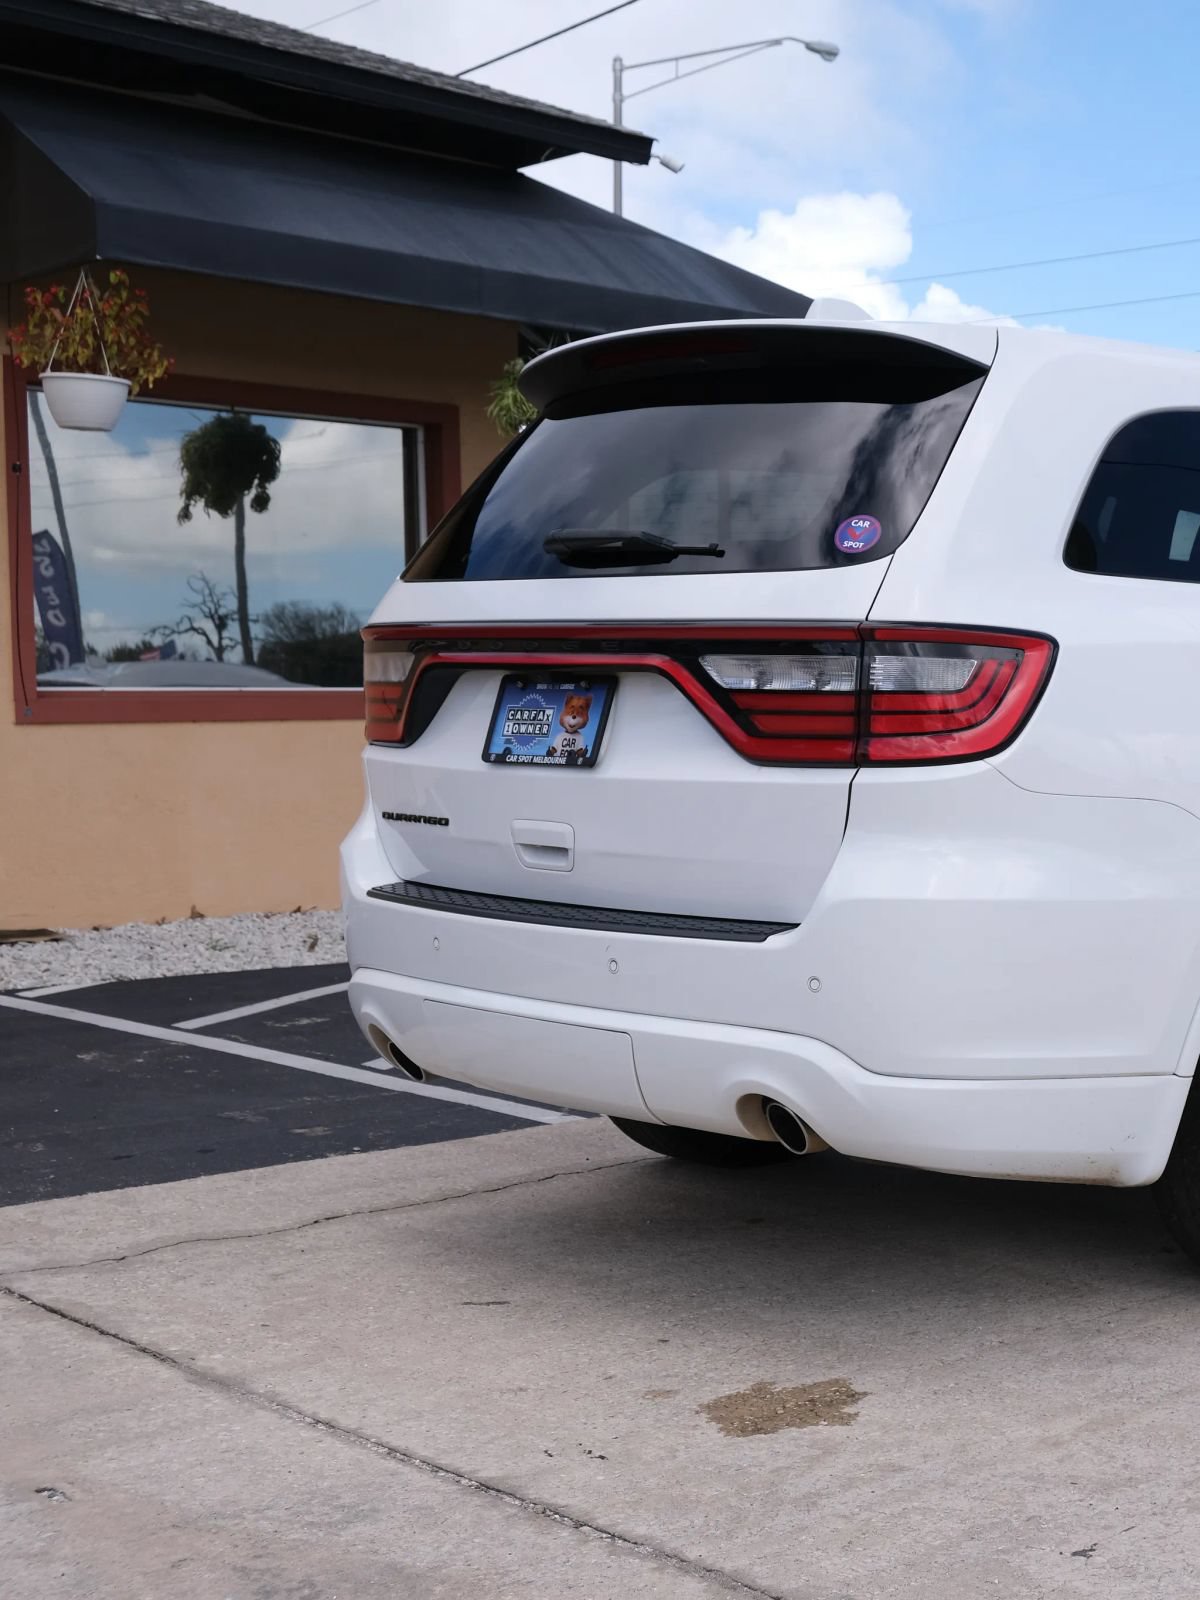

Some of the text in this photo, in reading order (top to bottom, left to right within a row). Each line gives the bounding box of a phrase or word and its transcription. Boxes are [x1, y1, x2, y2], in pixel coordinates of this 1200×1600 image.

[851, 519, 871, 528] CAR
[842, 540, 865, 549] SPOT
[508, 710, 553, 721] CARFAX
[512, 724, 549, 734] OWNER
[561, 737, 577, 749] CAR
[505, 754, 567, 764] CAR SPOT MELBOURNE
[382, 812, 449, 826] DURANGO
